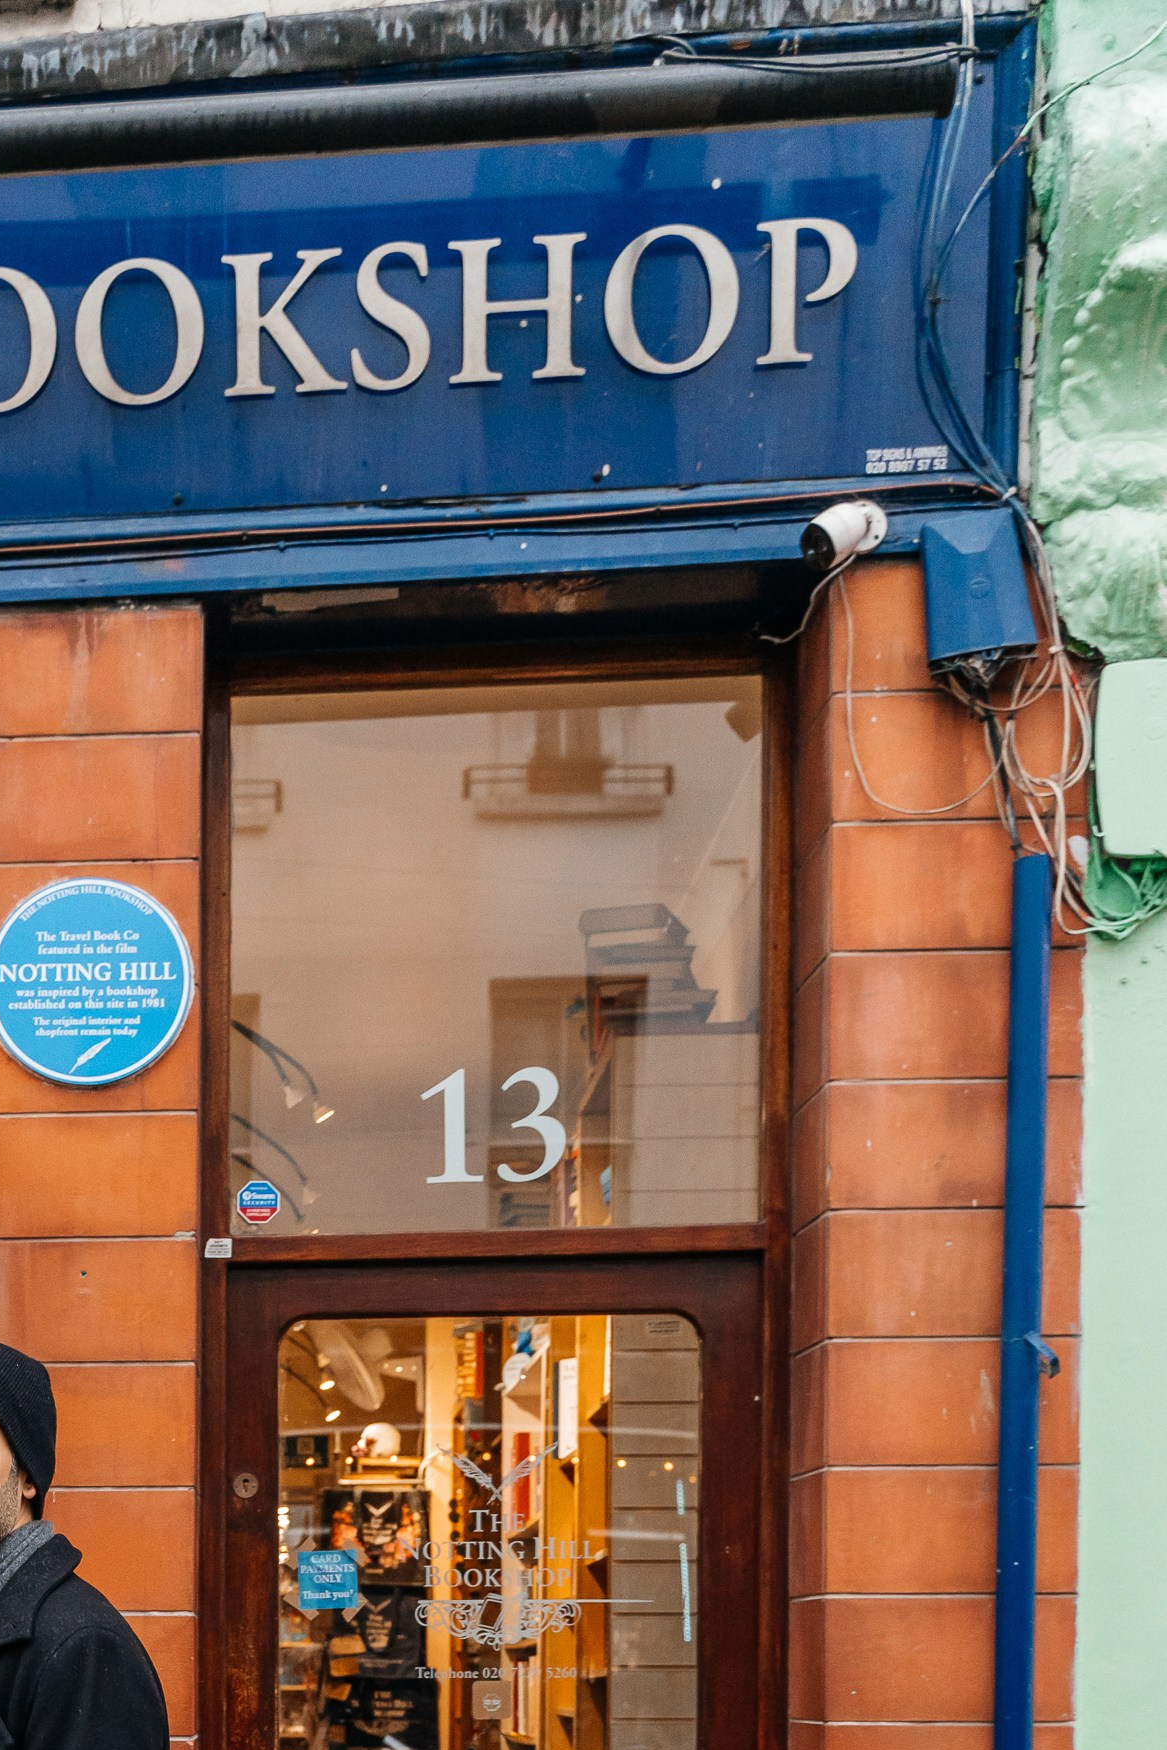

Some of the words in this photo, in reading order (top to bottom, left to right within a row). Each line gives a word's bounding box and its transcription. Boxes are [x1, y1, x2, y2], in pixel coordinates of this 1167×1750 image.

[19, 904, 38, 921] THE
[37, 886, 80, 908] NOTTING
[81, 885, 103, 894] HILL
[104, 885, 153, 916] BOOKSHOP
[36, 930, 57, 942] The
[59, 930, 91, 941] Travel
[94, 929, 120, 941] Book
[123, 929, 140, 940] Co
[38, 944, 80, 955] featured
[82, 943, 94, 954] in
[97, 943, 113, 954] the
[115, 942, 138, 954] film
[119, 961, 177, 981] HILL
[16, 988, 35, 997] was
[38, 986, 80, 1000] inspired
[82, 986, 95, 999] by
[98, 988, 104, 996] a
[106, 985, 158, 1000] bookshop
[8, 1000, 65, 1011] established
[68, 1001, 81, 1010] on
[84, 999, 104, 1010] this
[107, 999, 125, 1010] site
[127, 998, 139, 1009] in
[141, 998, 166, 1009] 1981
[33, 1016, 50, 1026] The
[52, 1015, 87, 1027] original
[88, 1015, 122, 1026] interior
[123, 1014, 141, 1025] and
[35, 1027, 78, 1038] shopfront
[80, 1027, 111, 1036] remain
[113, 1026, 138, 1038] today
[420, 1066, 568, 1184] 13
[469, 1509, 526, 1532] THE
[400, 1537, 525, 1560] NOTTING
[532, 1536, 597, 1559] HILL
[311, 1554, 341, 1563] CARD
[300, 1563, 355, 1573] PAYMENTS
[313, 1574, 342, 1583] ONLY
[423, 1565, 571, 1588] BOOKSHOP
[302, 1590, 332, 1599] Thank
[415, 1667, 479, 1680] Telephone
[483, 1667, 505, 1679] 020
[546, 1667, 577, 1679] 5260
